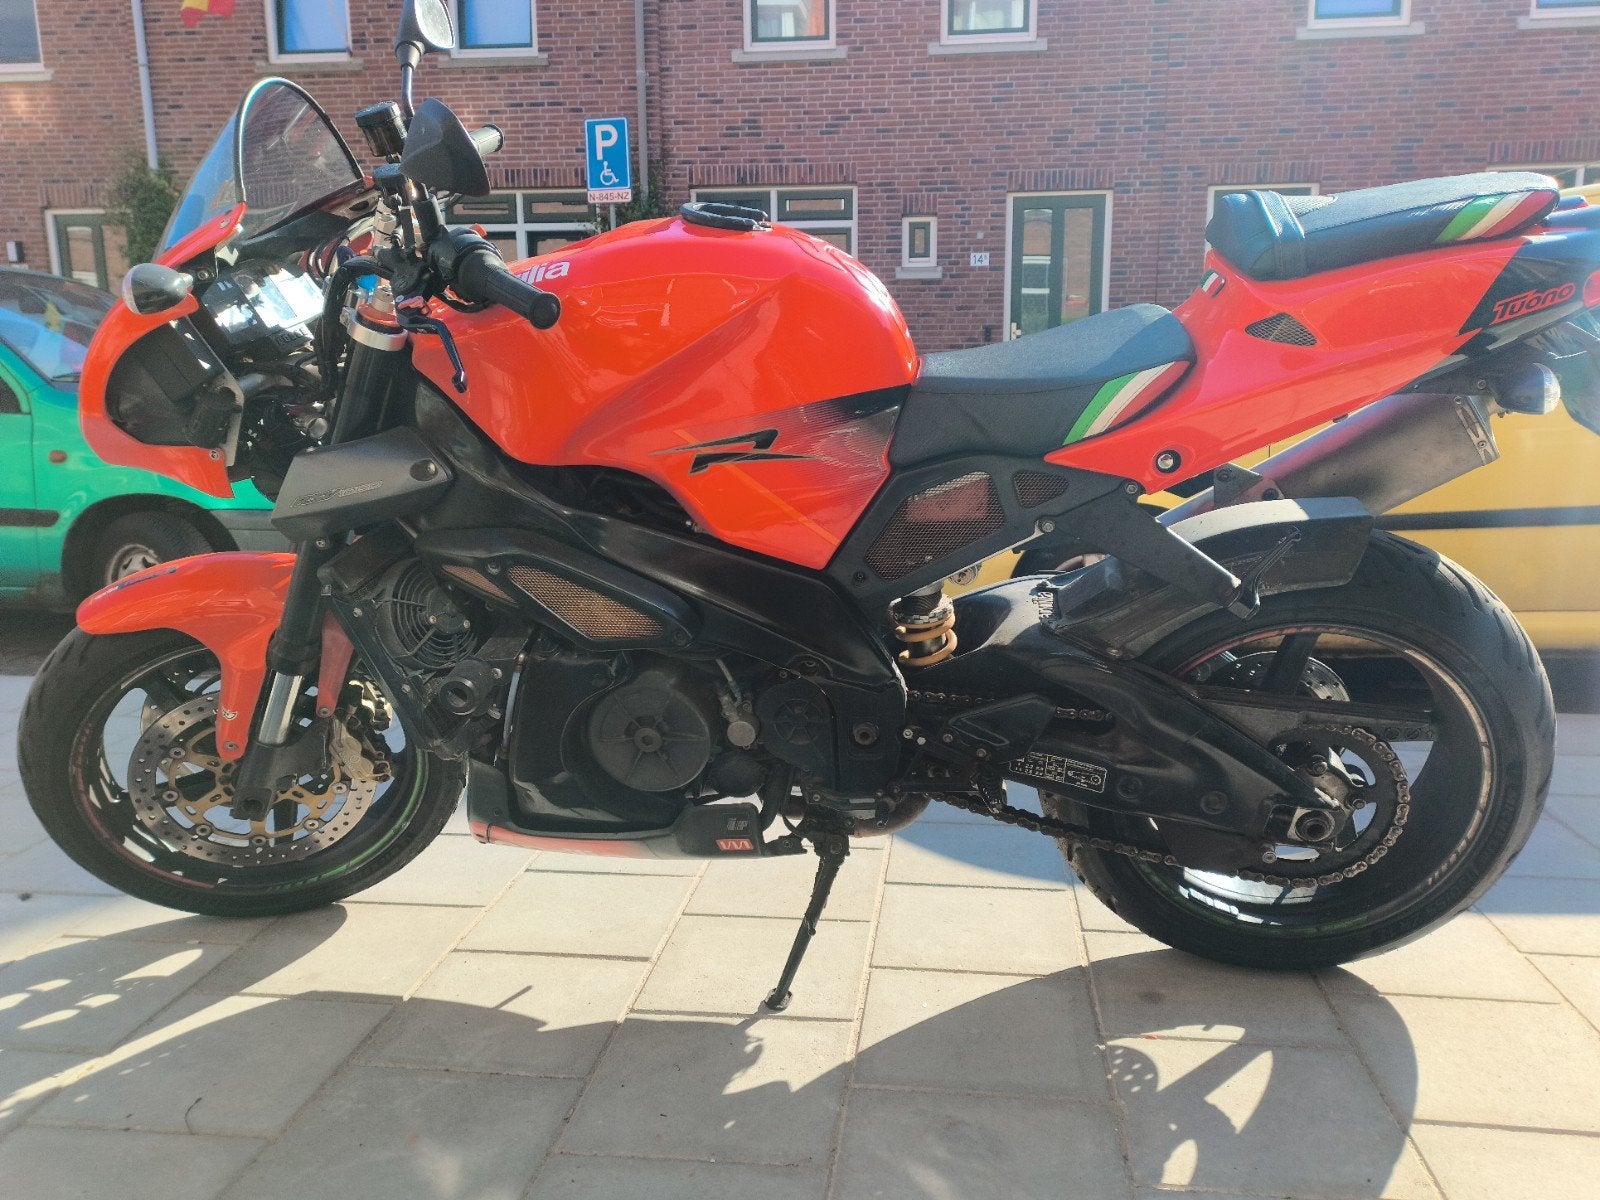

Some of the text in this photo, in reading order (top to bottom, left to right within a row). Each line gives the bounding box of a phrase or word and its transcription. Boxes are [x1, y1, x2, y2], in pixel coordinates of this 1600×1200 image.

[594, 124, 618, 160] P
[589, 192, 630, 202] N-845-NZ
[515, 261, 571, 285] ilia
[1489, 282, 1576, 327] Tuono
